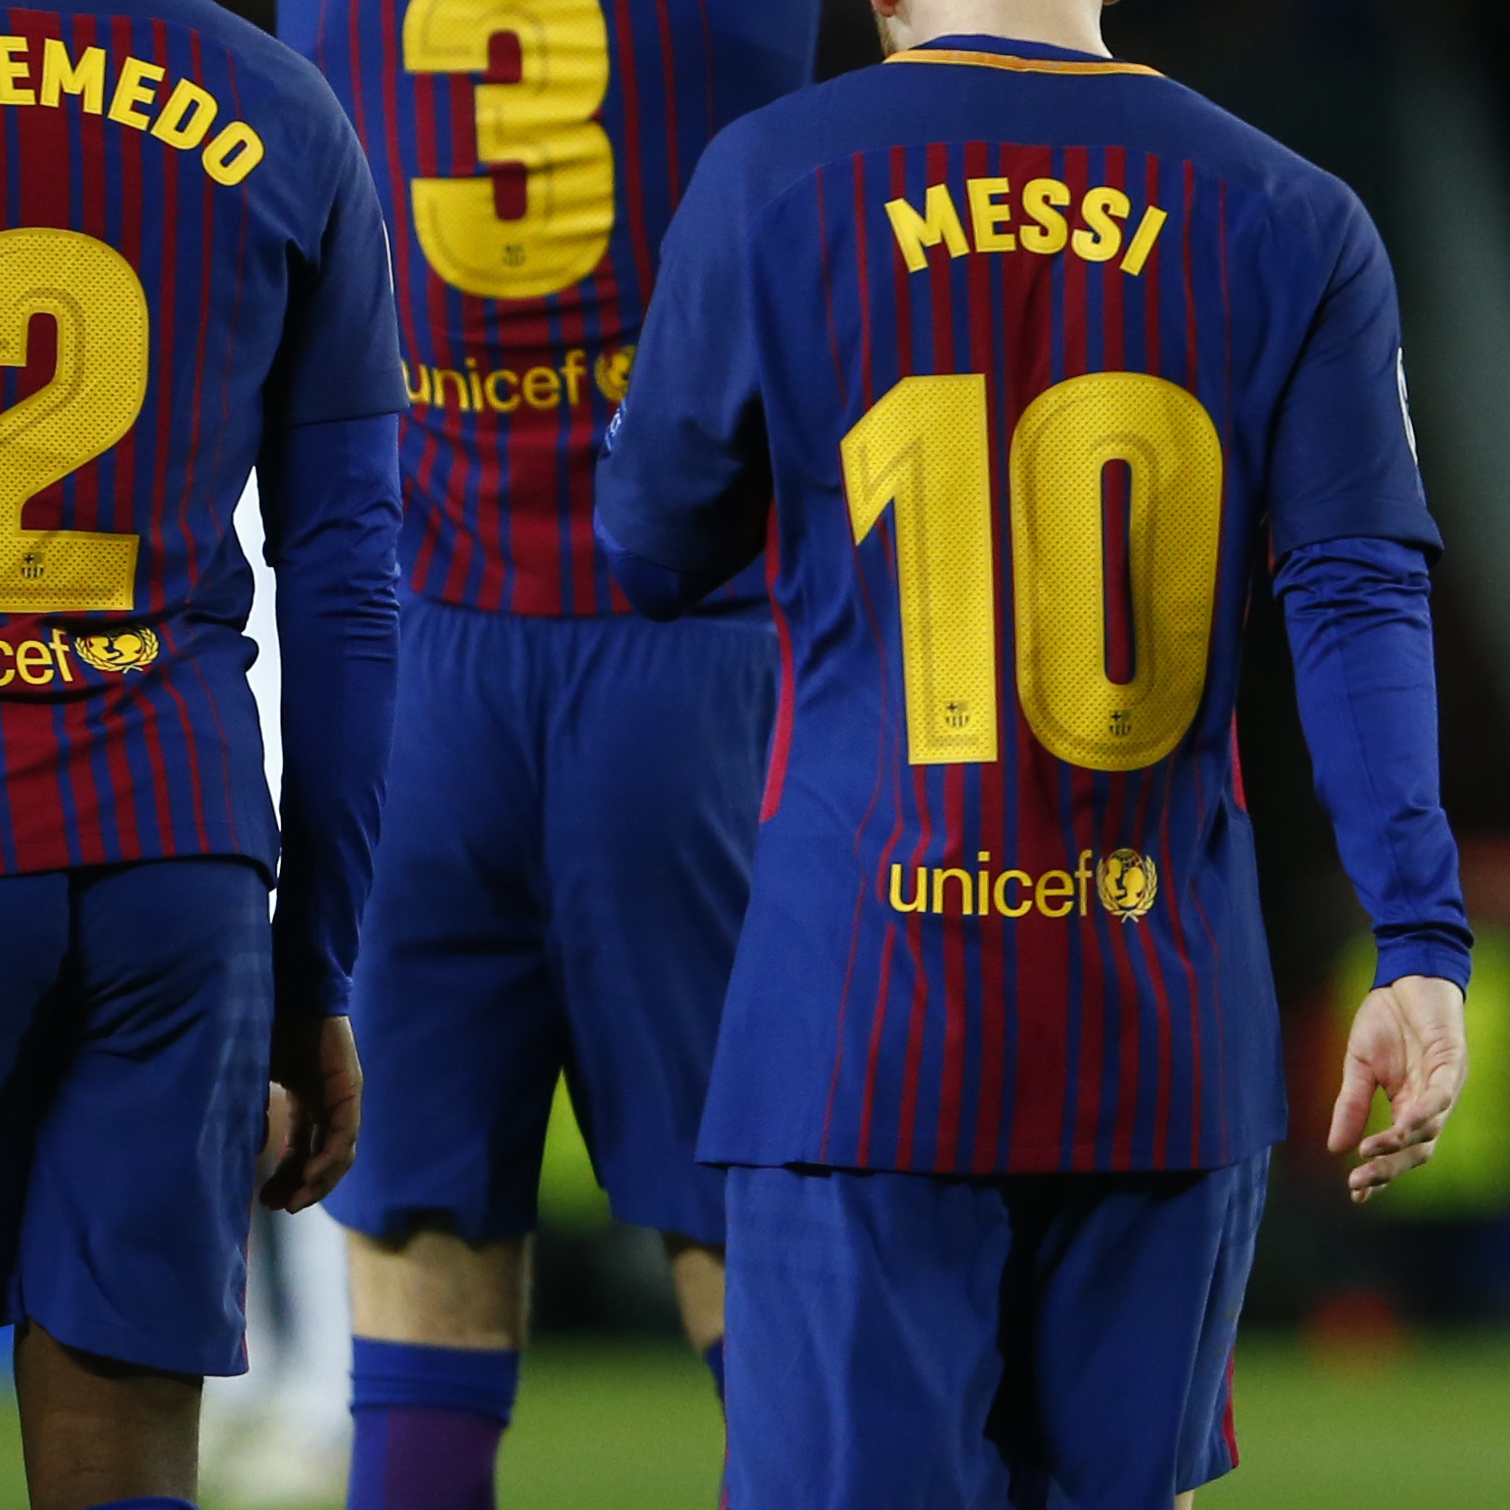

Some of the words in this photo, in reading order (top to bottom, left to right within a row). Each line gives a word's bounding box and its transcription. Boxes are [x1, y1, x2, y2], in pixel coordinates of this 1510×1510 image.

[884, 176, 1168, 277] MESSI
[400, 348, 587, 414] unicef
[839, 371, 1224, 771] 10
[888, 848, 1094, 918] unicef
